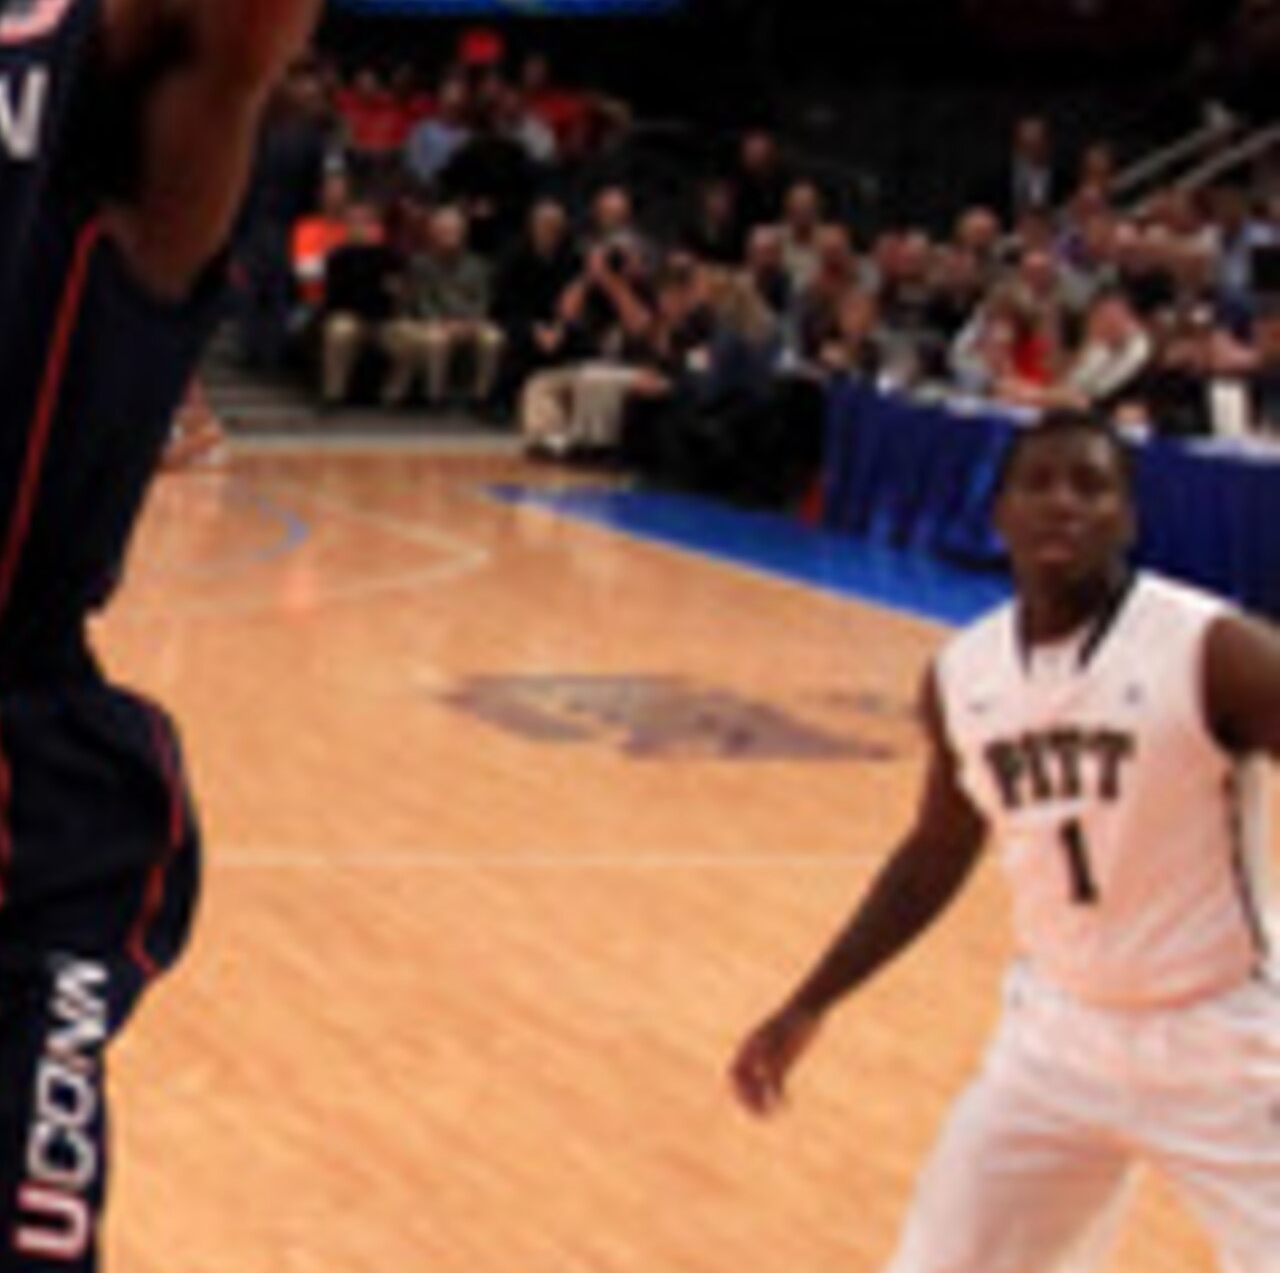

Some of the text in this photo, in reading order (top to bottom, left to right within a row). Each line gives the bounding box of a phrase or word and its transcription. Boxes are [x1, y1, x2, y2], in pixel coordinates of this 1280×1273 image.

[984, 729, 1134, 811] PITT
[1059, 818, 1100, 908] 1
[14, 956, 109, 1261] UCONN
